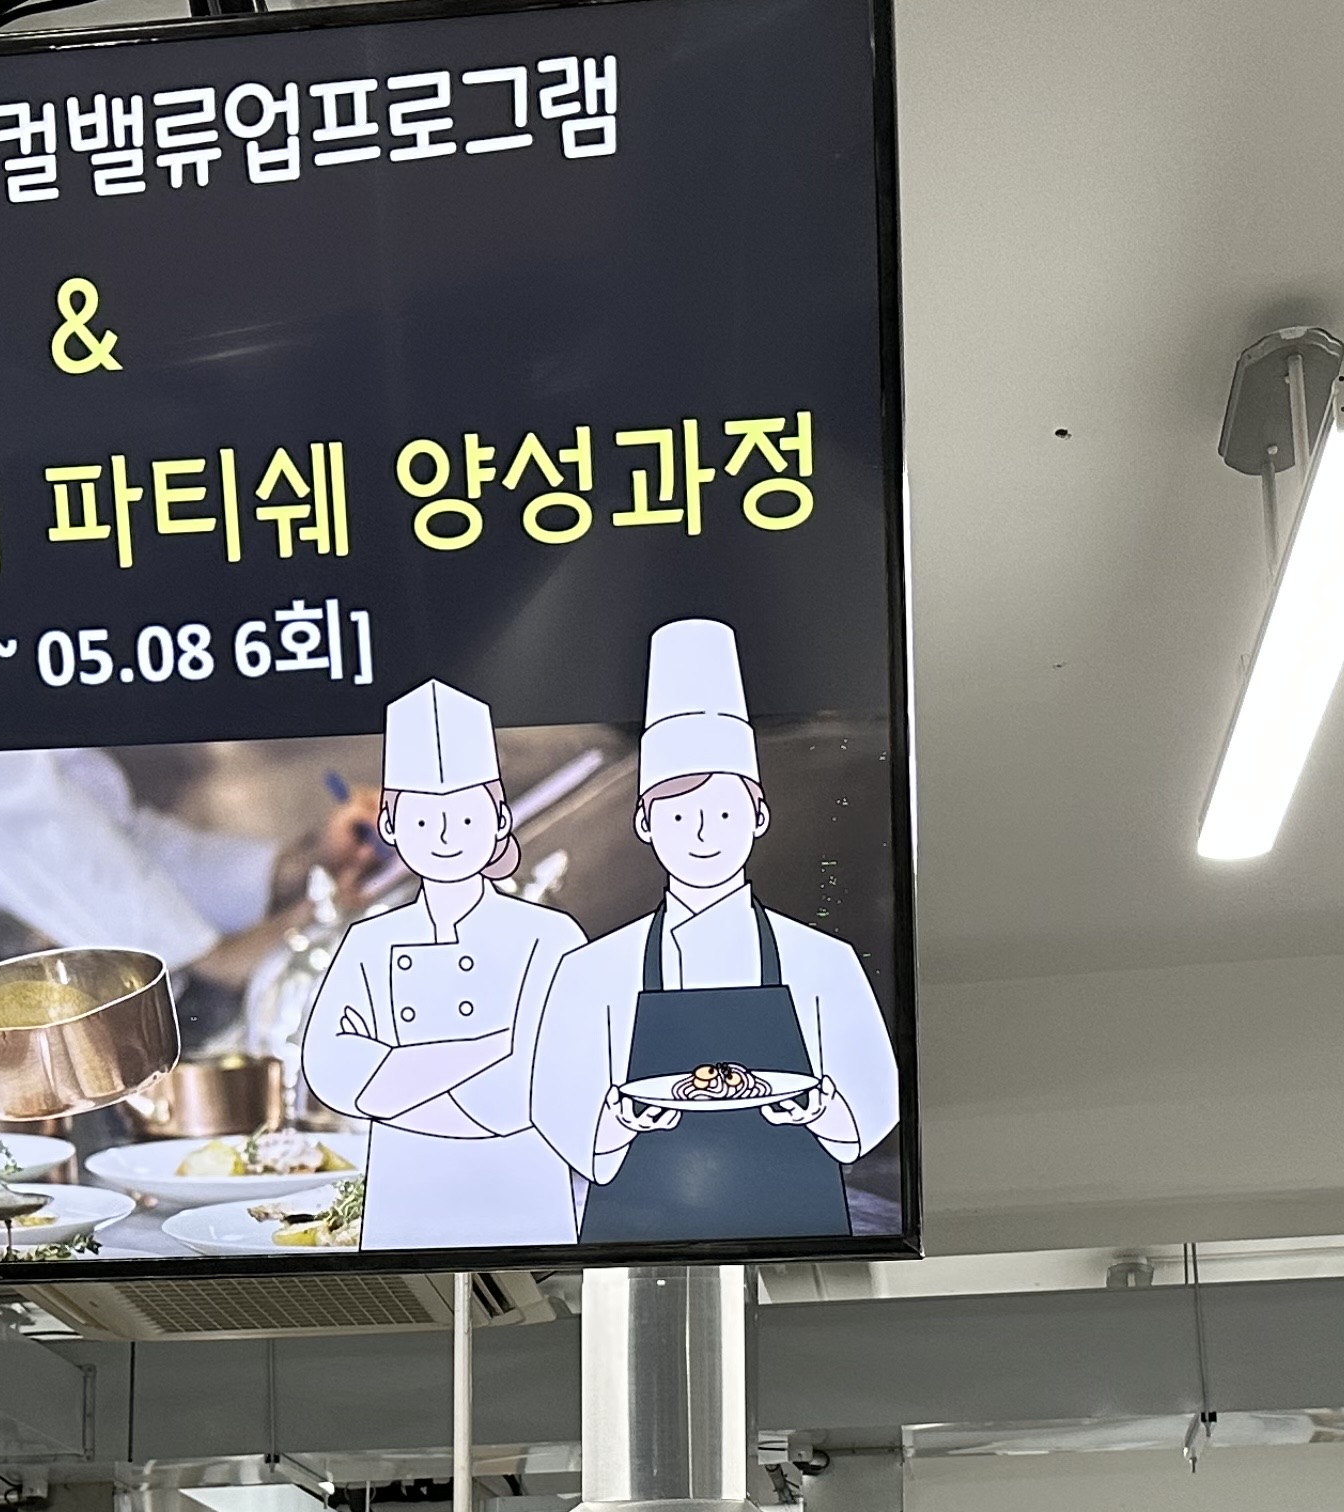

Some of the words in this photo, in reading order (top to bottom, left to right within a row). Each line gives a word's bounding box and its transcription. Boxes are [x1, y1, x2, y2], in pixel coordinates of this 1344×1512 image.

[51, 277, 124, 374] &
[45, 441, 349, 568] 파티쉐
[396, 411, 814, 551] 양성과정
[37, 623, 215, 687] 05.08
[234, 598, 373, 685] 6회]
